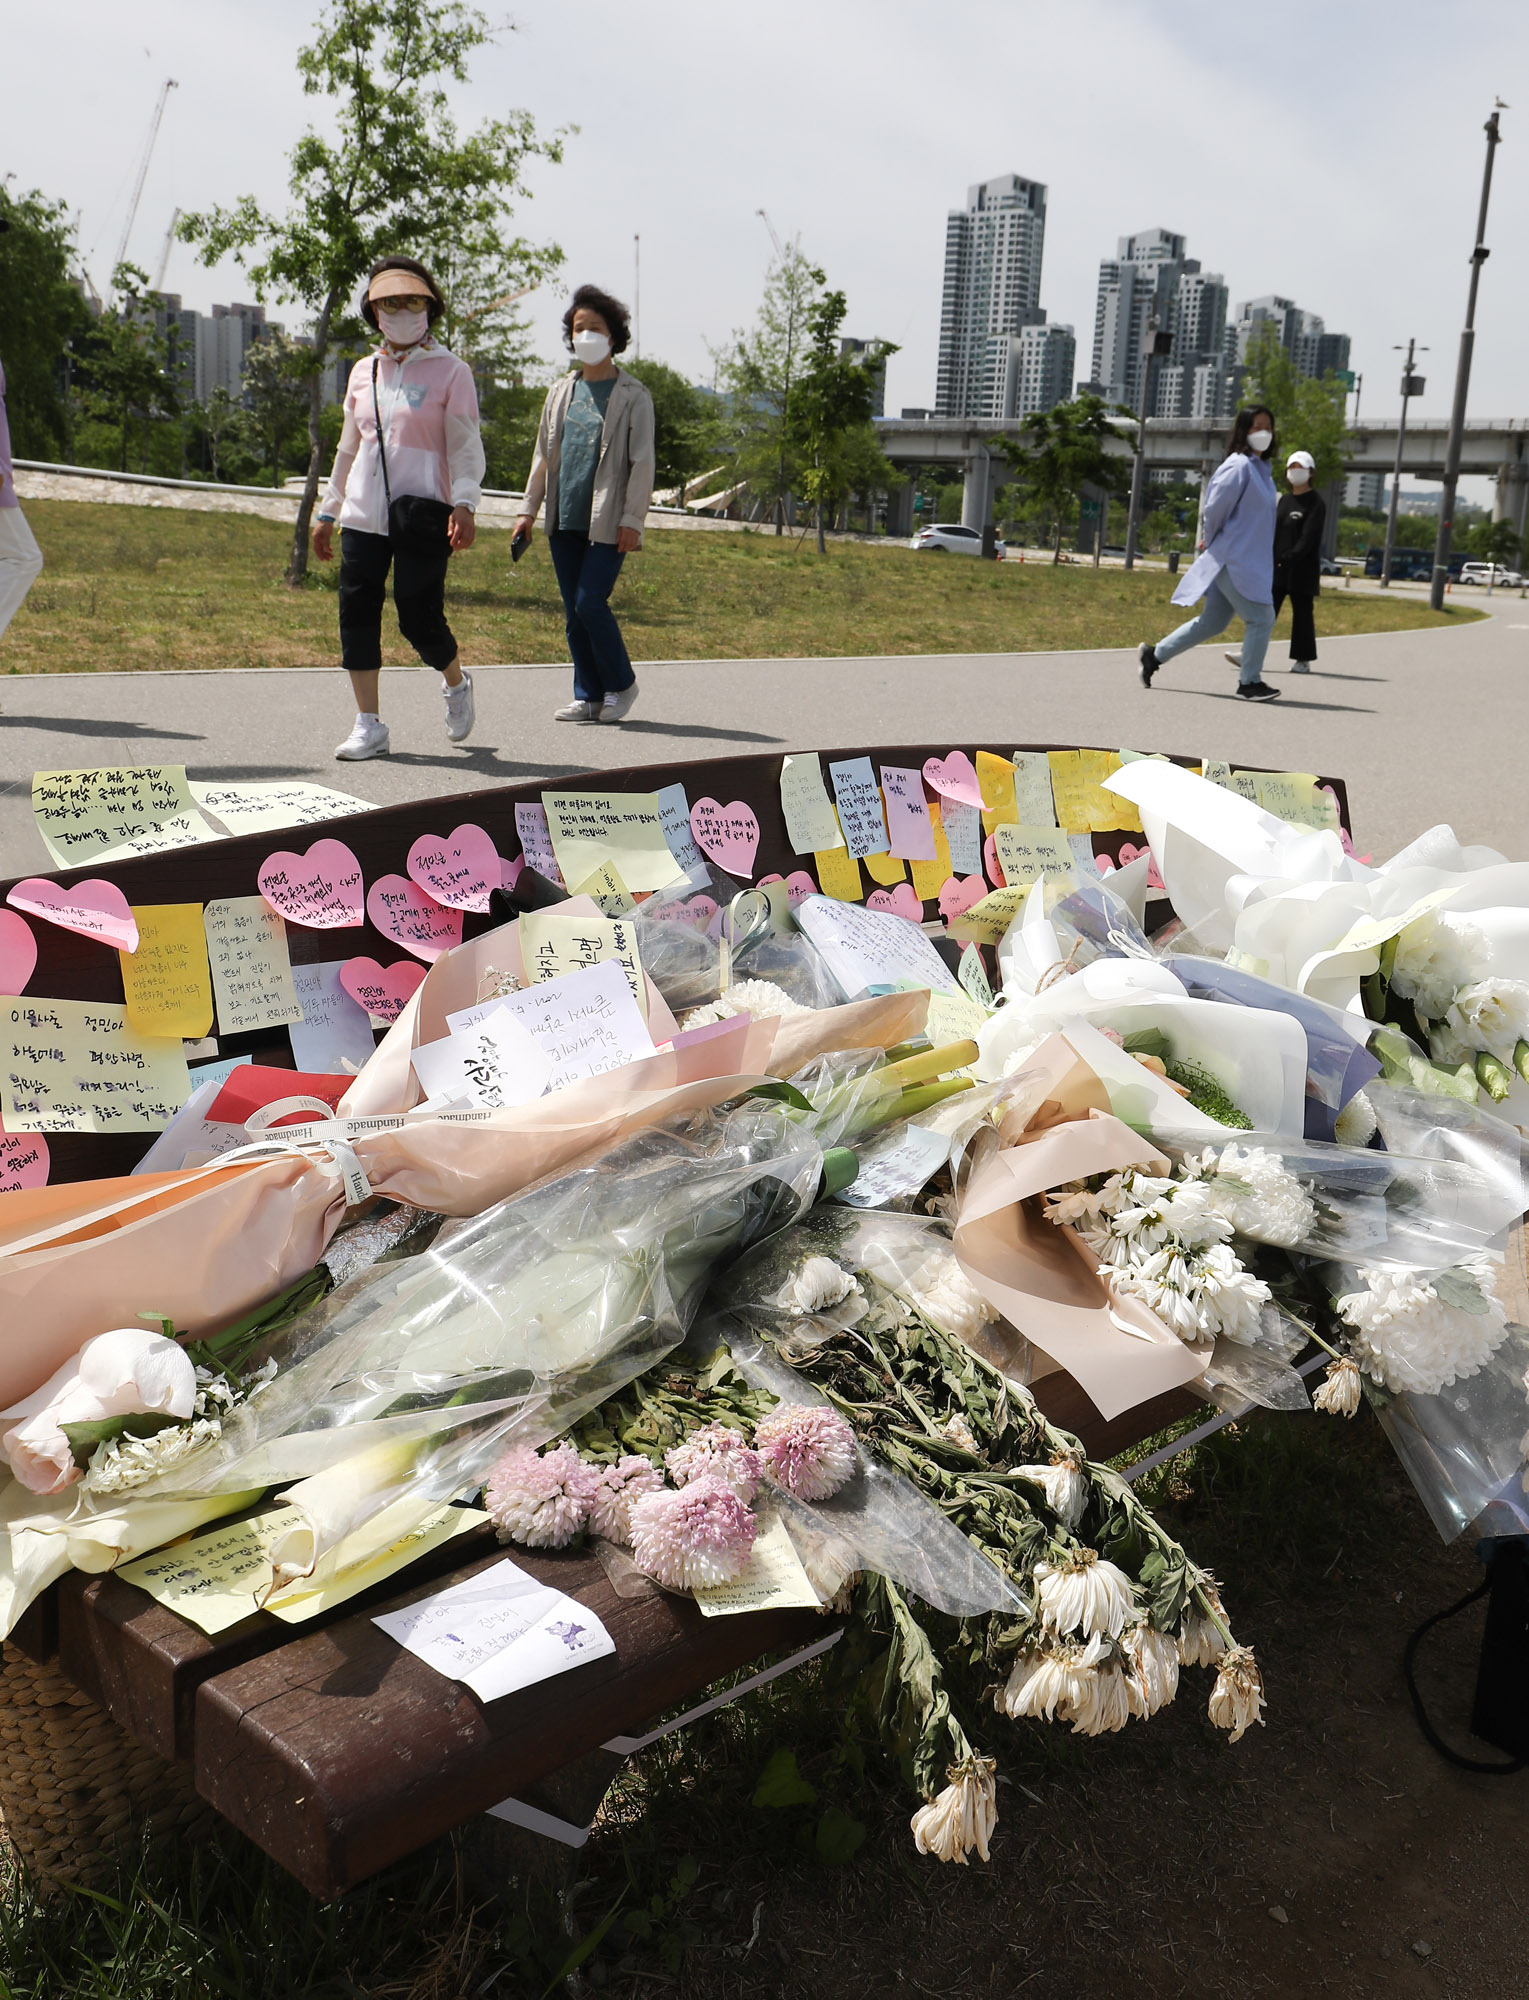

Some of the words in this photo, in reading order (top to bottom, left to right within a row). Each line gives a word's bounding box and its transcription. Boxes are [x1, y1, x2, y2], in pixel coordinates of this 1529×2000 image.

[568, 994, 616, 1022] 끝까지
[84, 1015, 124, 1033] 정민아
[546, 1027, 617, 1061] 힘내세요
[264, 1127, 312, 1141] Handmade
[347, 1118, 405, 1132] Handmade
